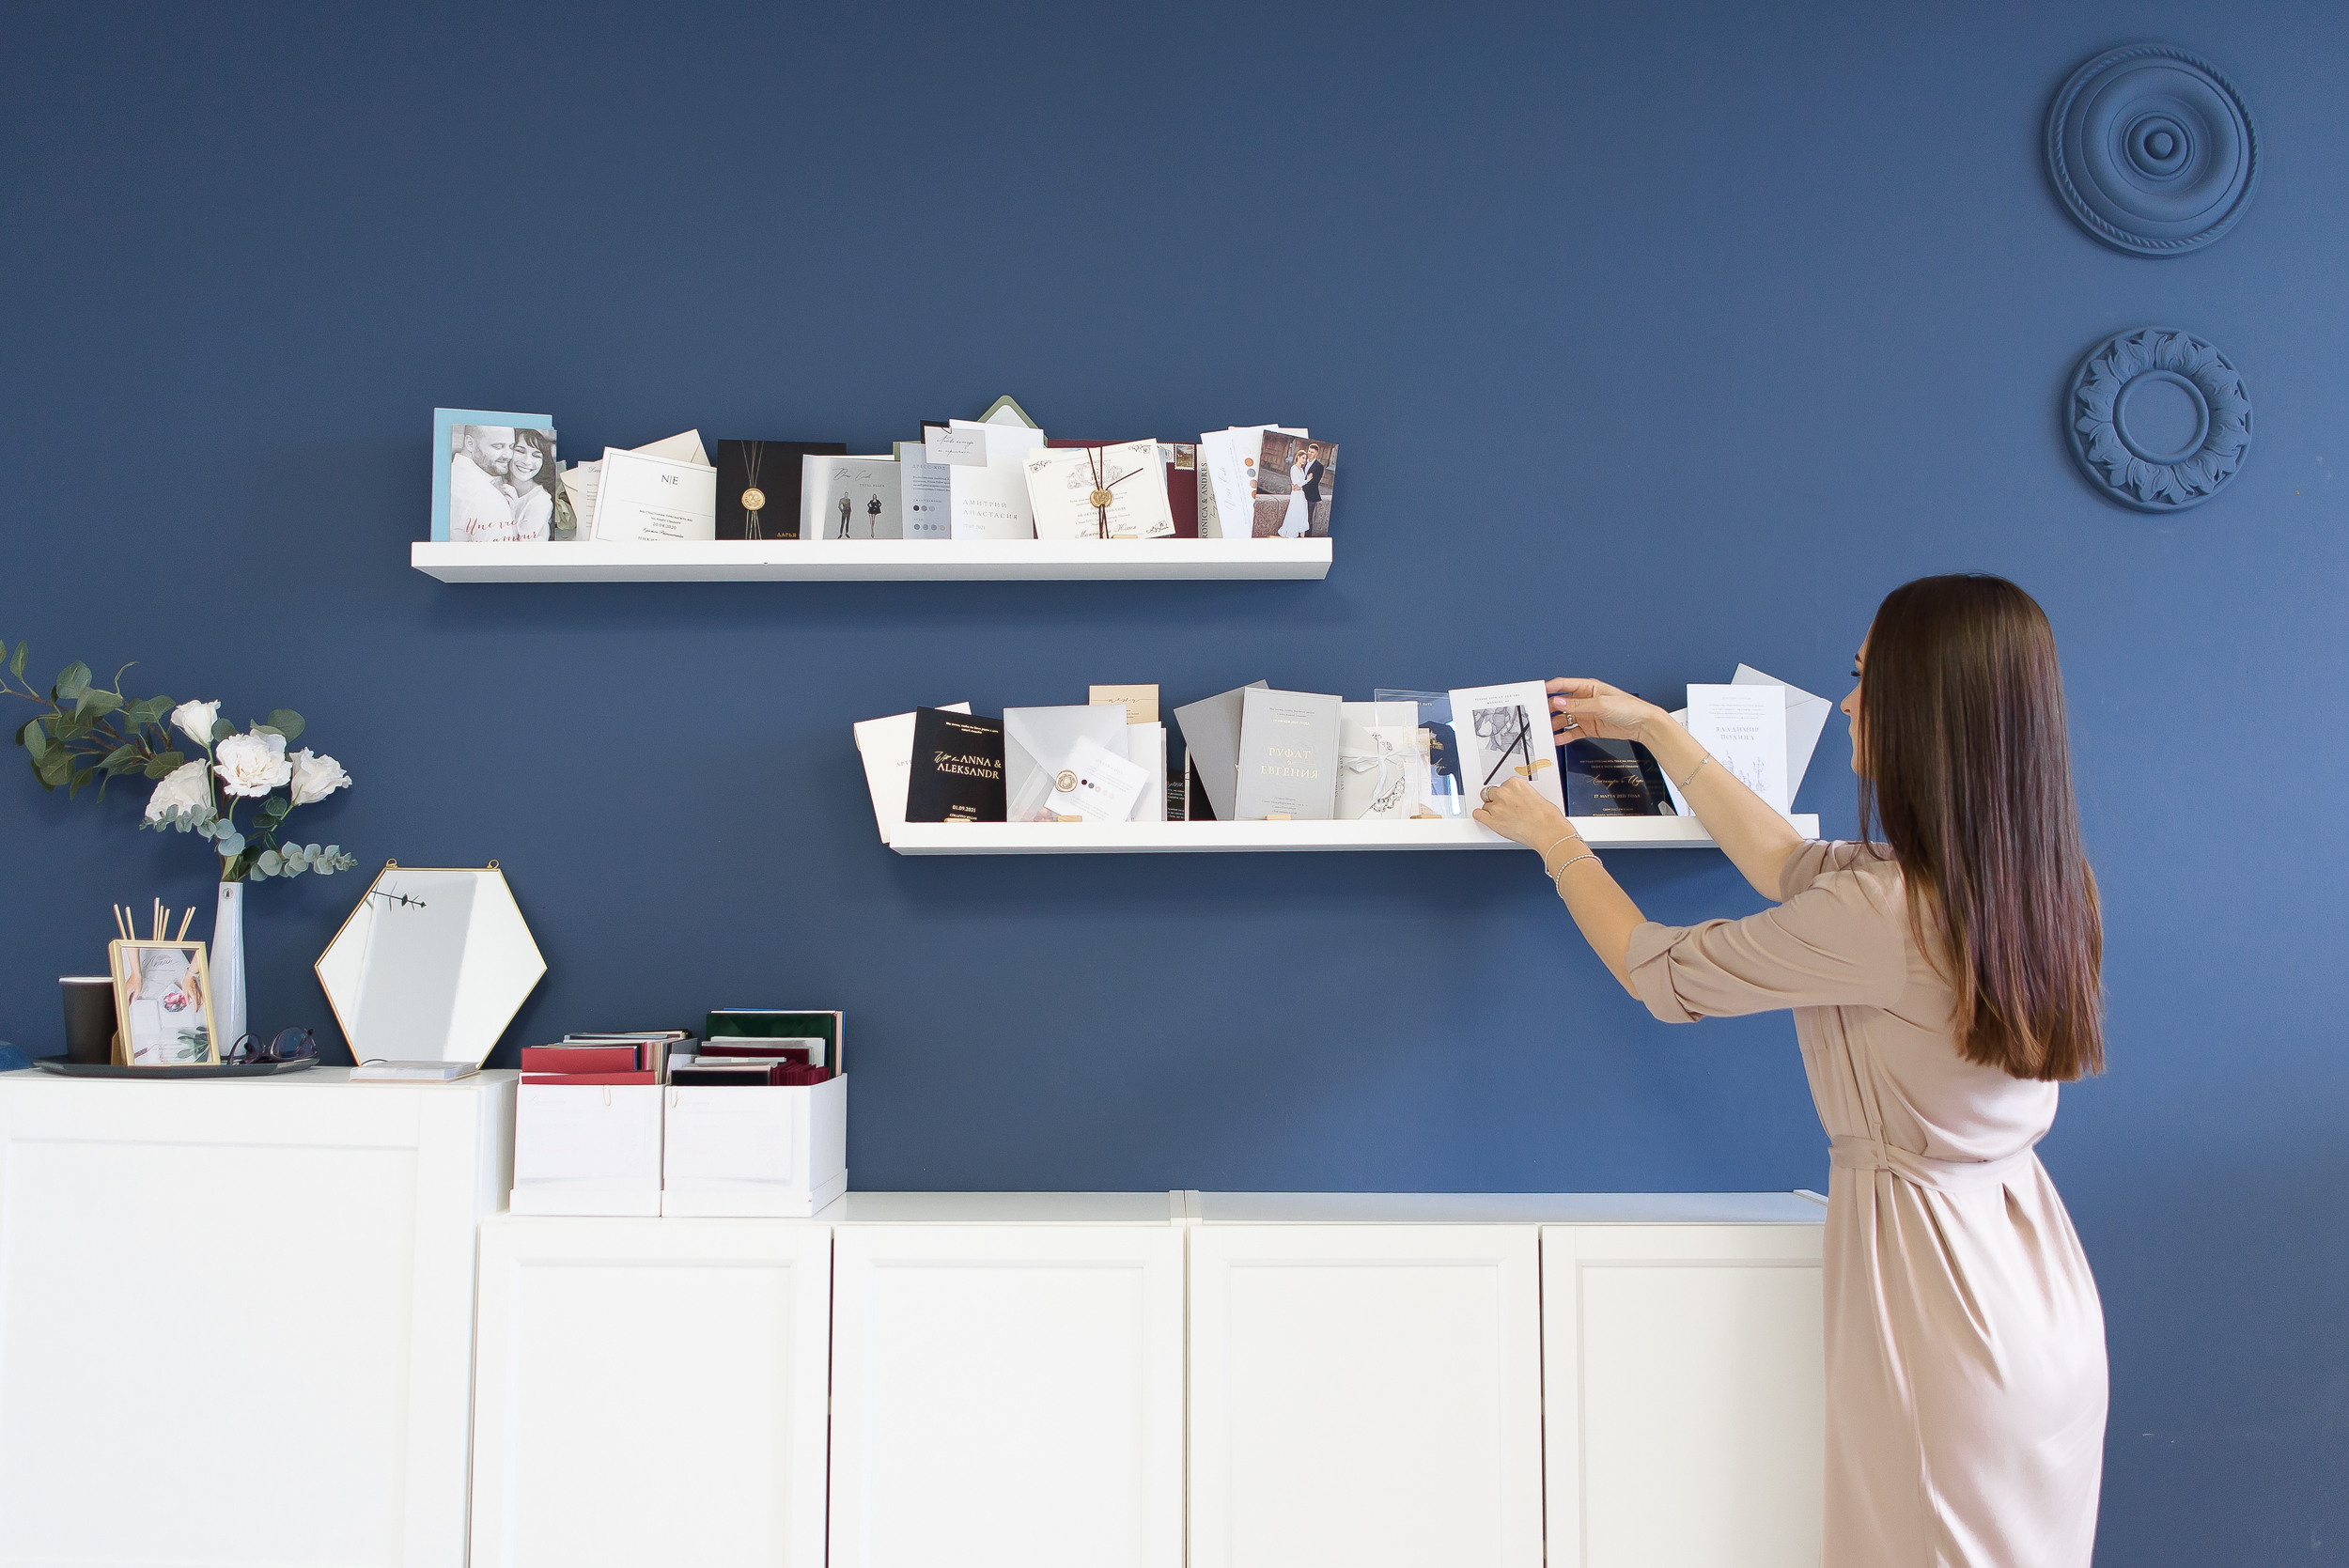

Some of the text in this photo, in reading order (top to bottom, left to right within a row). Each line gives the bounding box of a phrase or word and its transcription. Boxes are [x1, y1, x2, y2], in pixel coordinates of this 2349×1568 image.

[959, 753, 991, 768] ANNA
[993, 759, 1002, 768] &
[937, 762, 1000, 780] ALEKSANDR
[1260, 765, 1318, 779] ЕВГЕНИЯ
